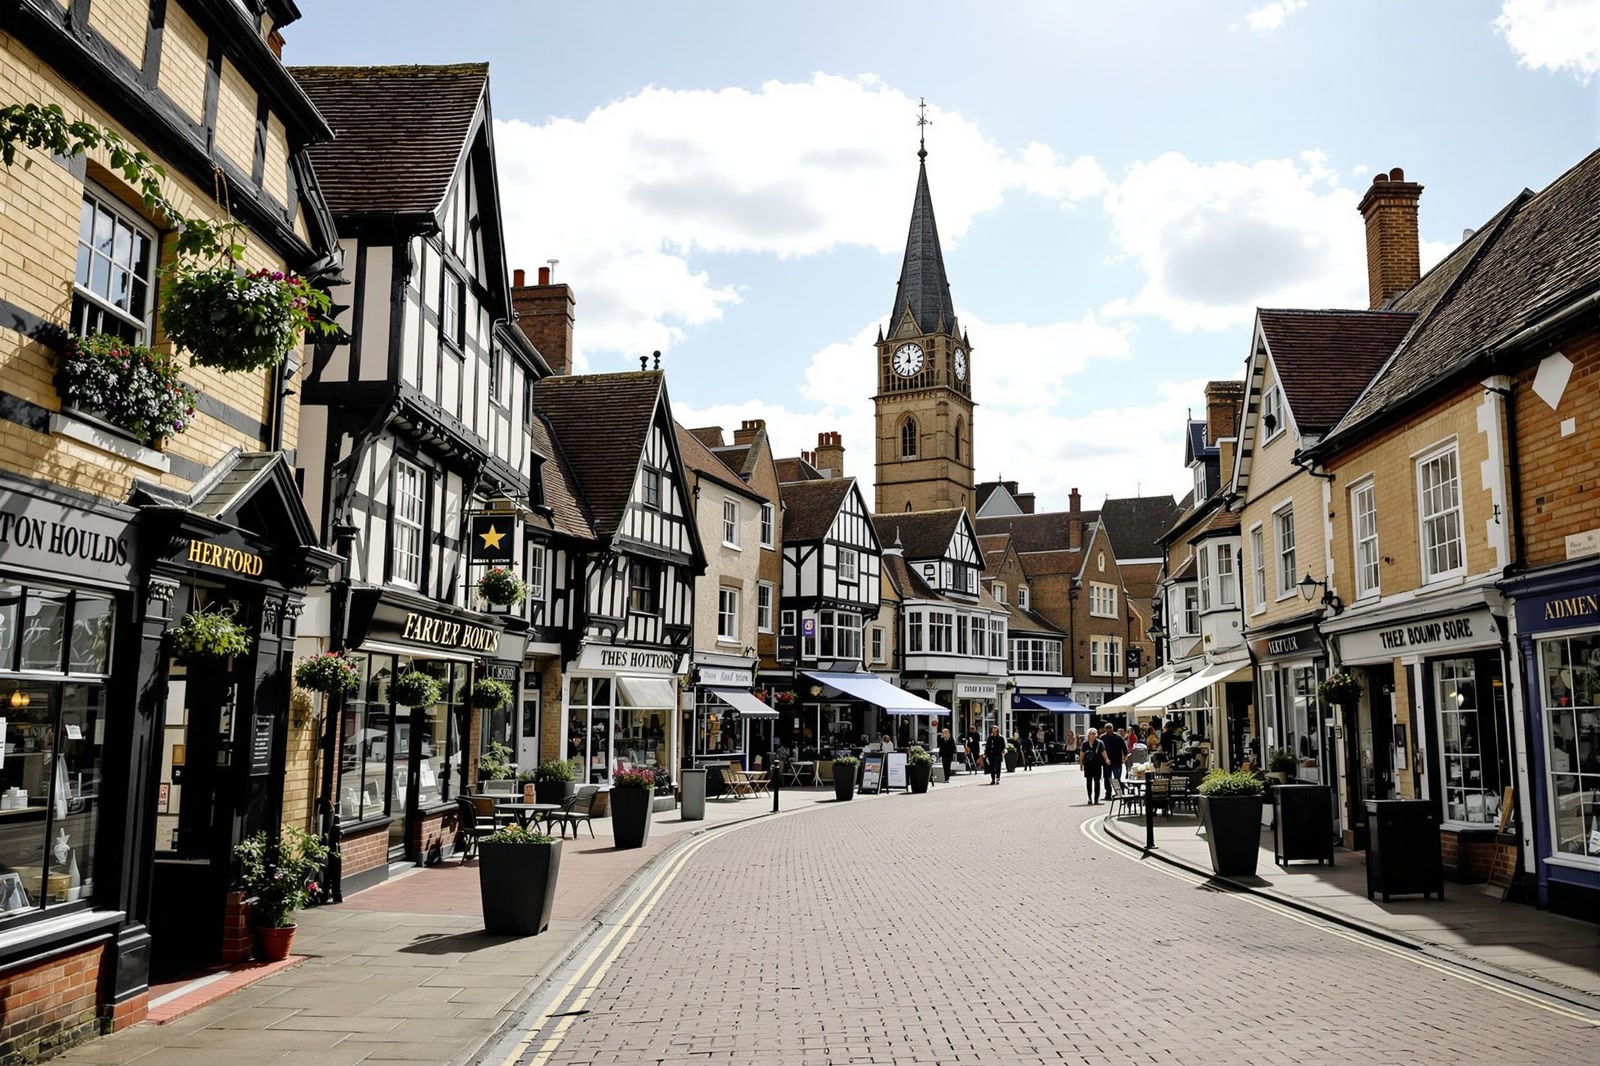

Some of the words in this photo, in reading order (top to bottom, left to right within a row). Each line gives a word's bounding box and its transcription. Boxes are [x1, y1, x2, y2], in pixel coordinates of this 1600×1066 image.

[48, 522, 128, 566] HOULDS
[187, 539, 263, 576] HERFORD
[1407, 623, 1442, 645] BOUMP
[601, 650, 628, 666] THES
[630, 652, 674, 669] HOTTORS
